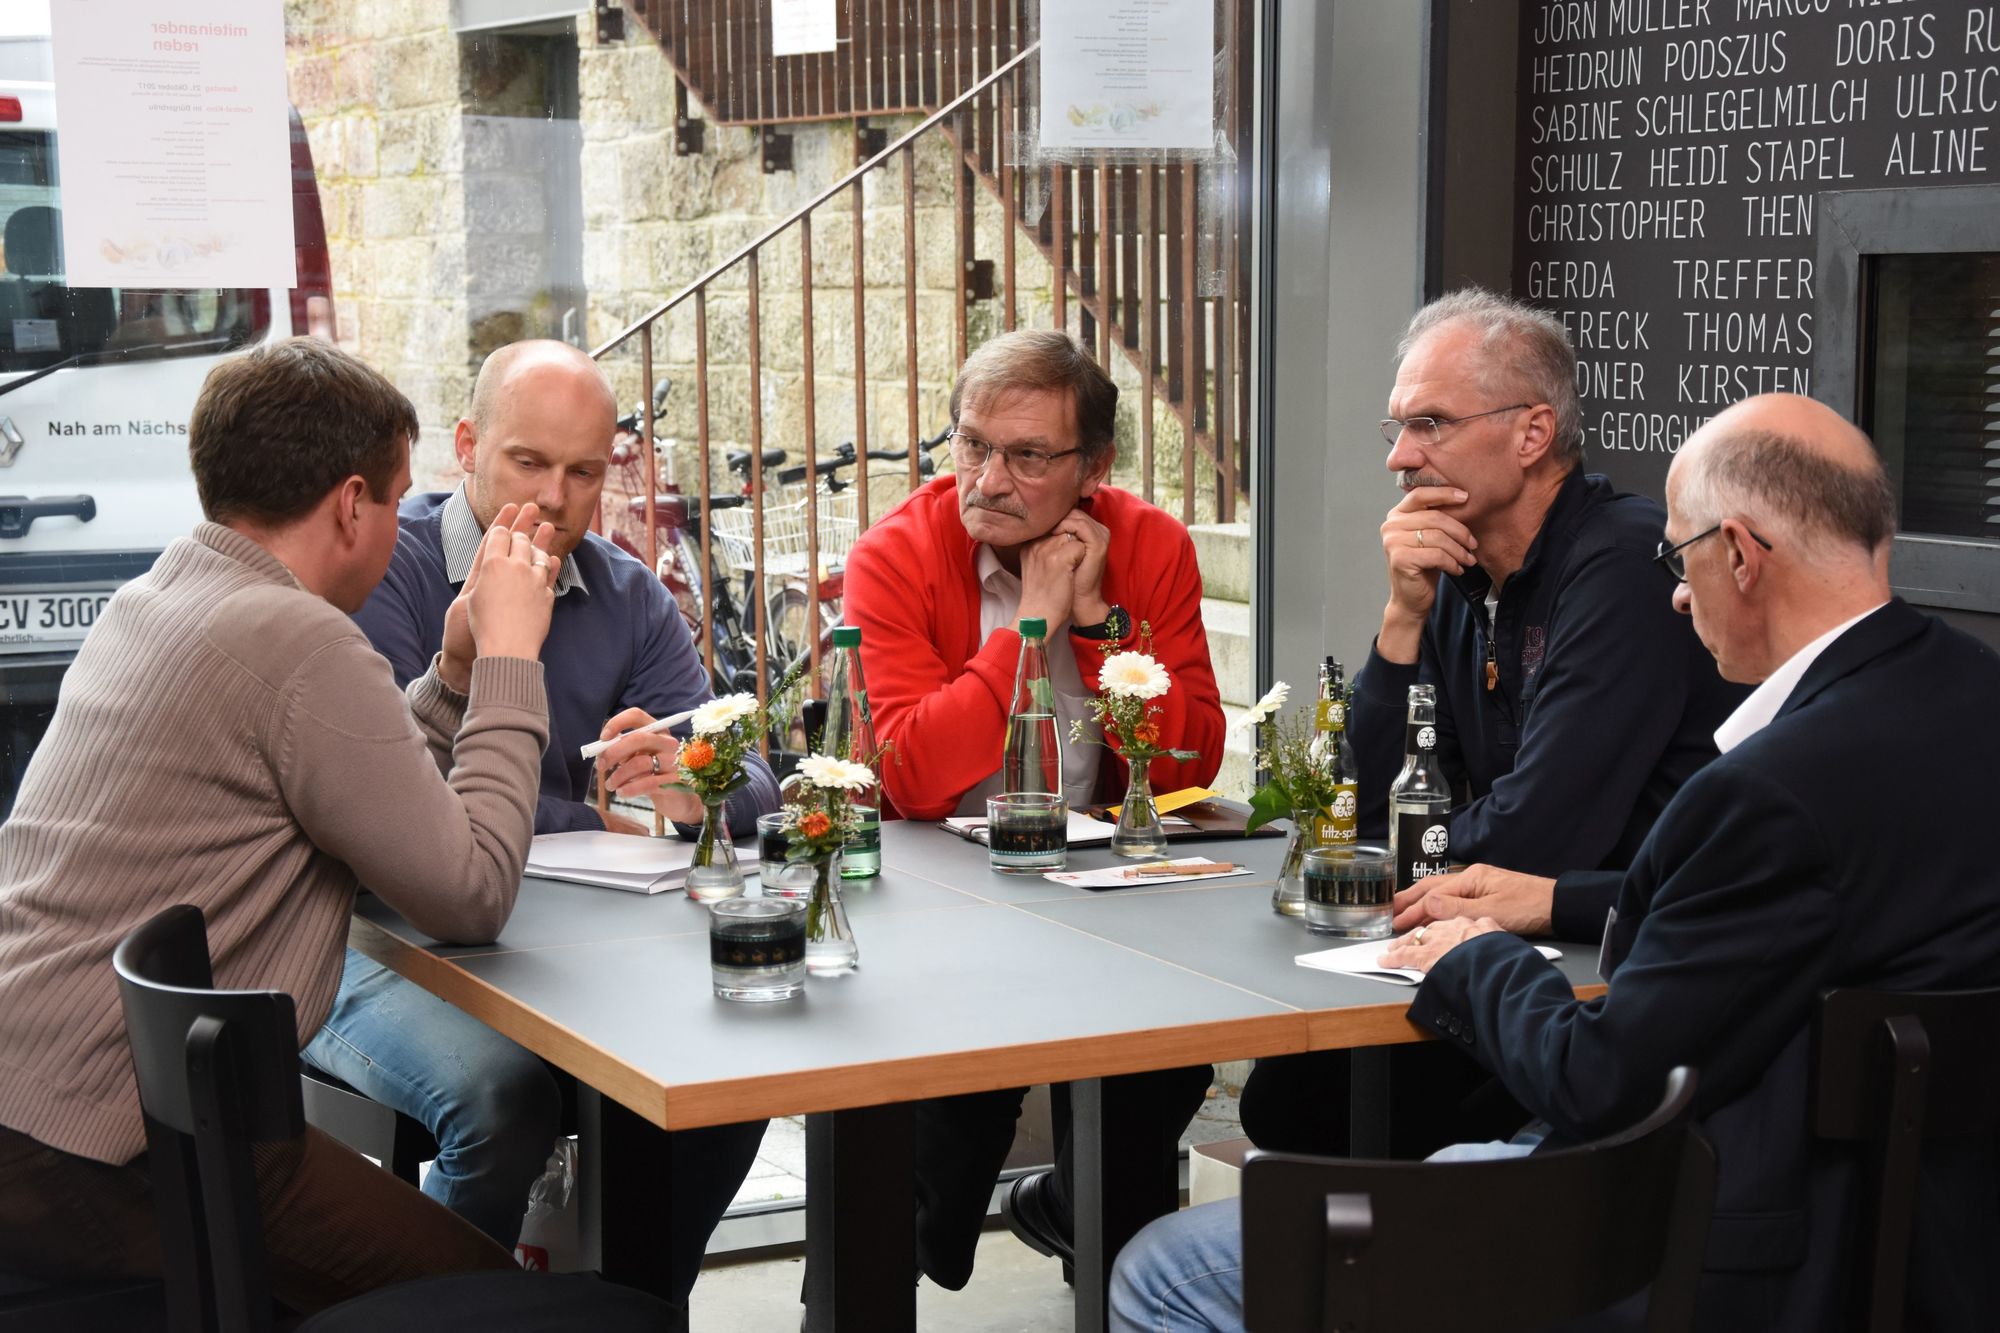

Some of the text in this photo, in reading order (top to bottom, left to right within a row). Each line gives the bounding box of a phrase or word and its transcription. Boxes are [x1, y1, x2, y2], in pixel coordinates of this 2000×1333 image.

[1534, 0, 1597, 45] JÖRN
[1533, 46, 1642, 95] HEIDRUN
[1664, 30, 1788, 83] PODSZUS
[1836, 13, 1936, 67] DORIS
[1531, 66, 2000, 145] SABINE SCHLEGELMILCH ULRIC
[1529, 126, 1990, 195] SCHULZ HEIDI STAPEL ALINE
[1528, 194, 1813, 243] CHRISTOPHER THEN
[1528, 257, 1814, 301] GERDA TREFFER
[1553, 310, 1813, 355] ERECK THOMAS
[1678, 363, 1809, 405] KIRSTEN
[48, 420, 187, 436] Nah am Nächs
